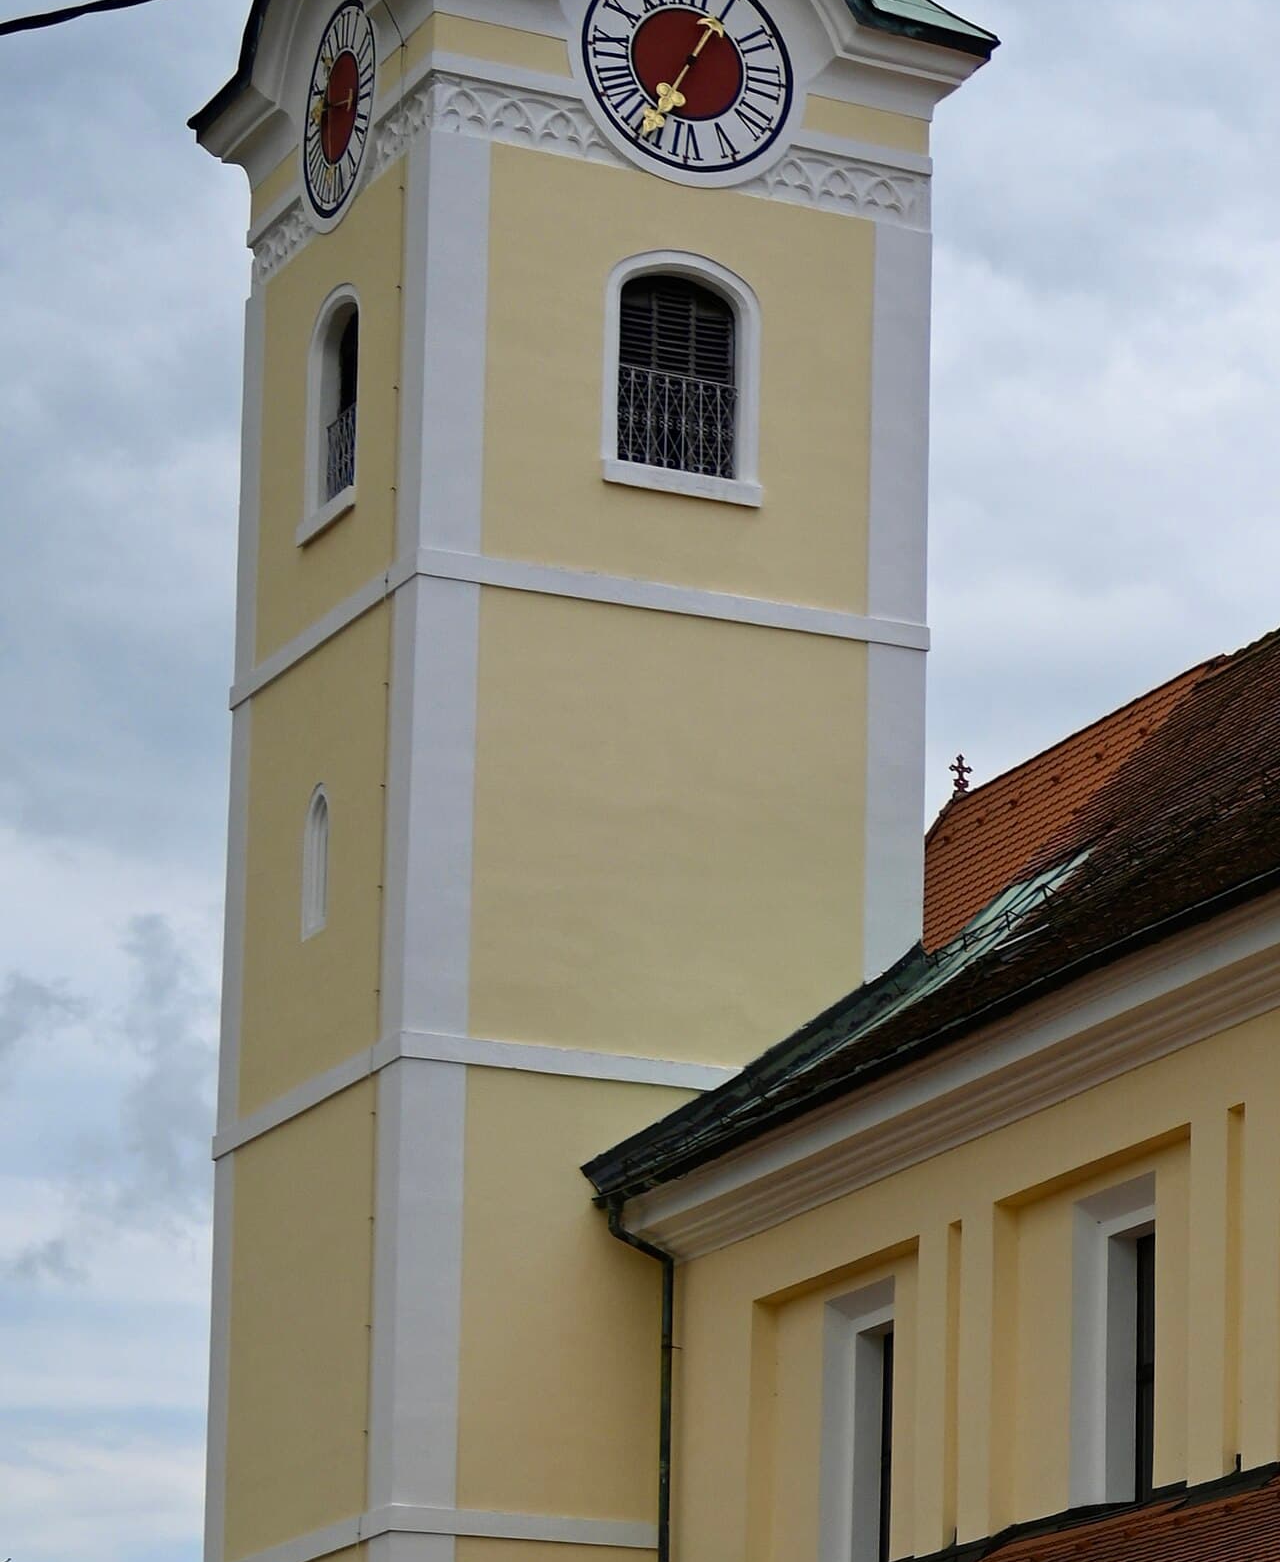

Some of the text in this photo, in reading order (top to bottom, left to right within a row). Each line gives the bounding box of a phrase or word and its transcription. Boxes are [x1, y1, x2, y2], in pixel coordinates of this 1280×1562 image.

[592, 25, 630, 62] IX
[735, 25, 774, 57] II
[595, 65, 641, 114] VIII
[744, 62, 782, 105] III
[668, 119, 704, 161] VI
[714, 122, 741, 159] V
[734, 97, 774, 142] IV
